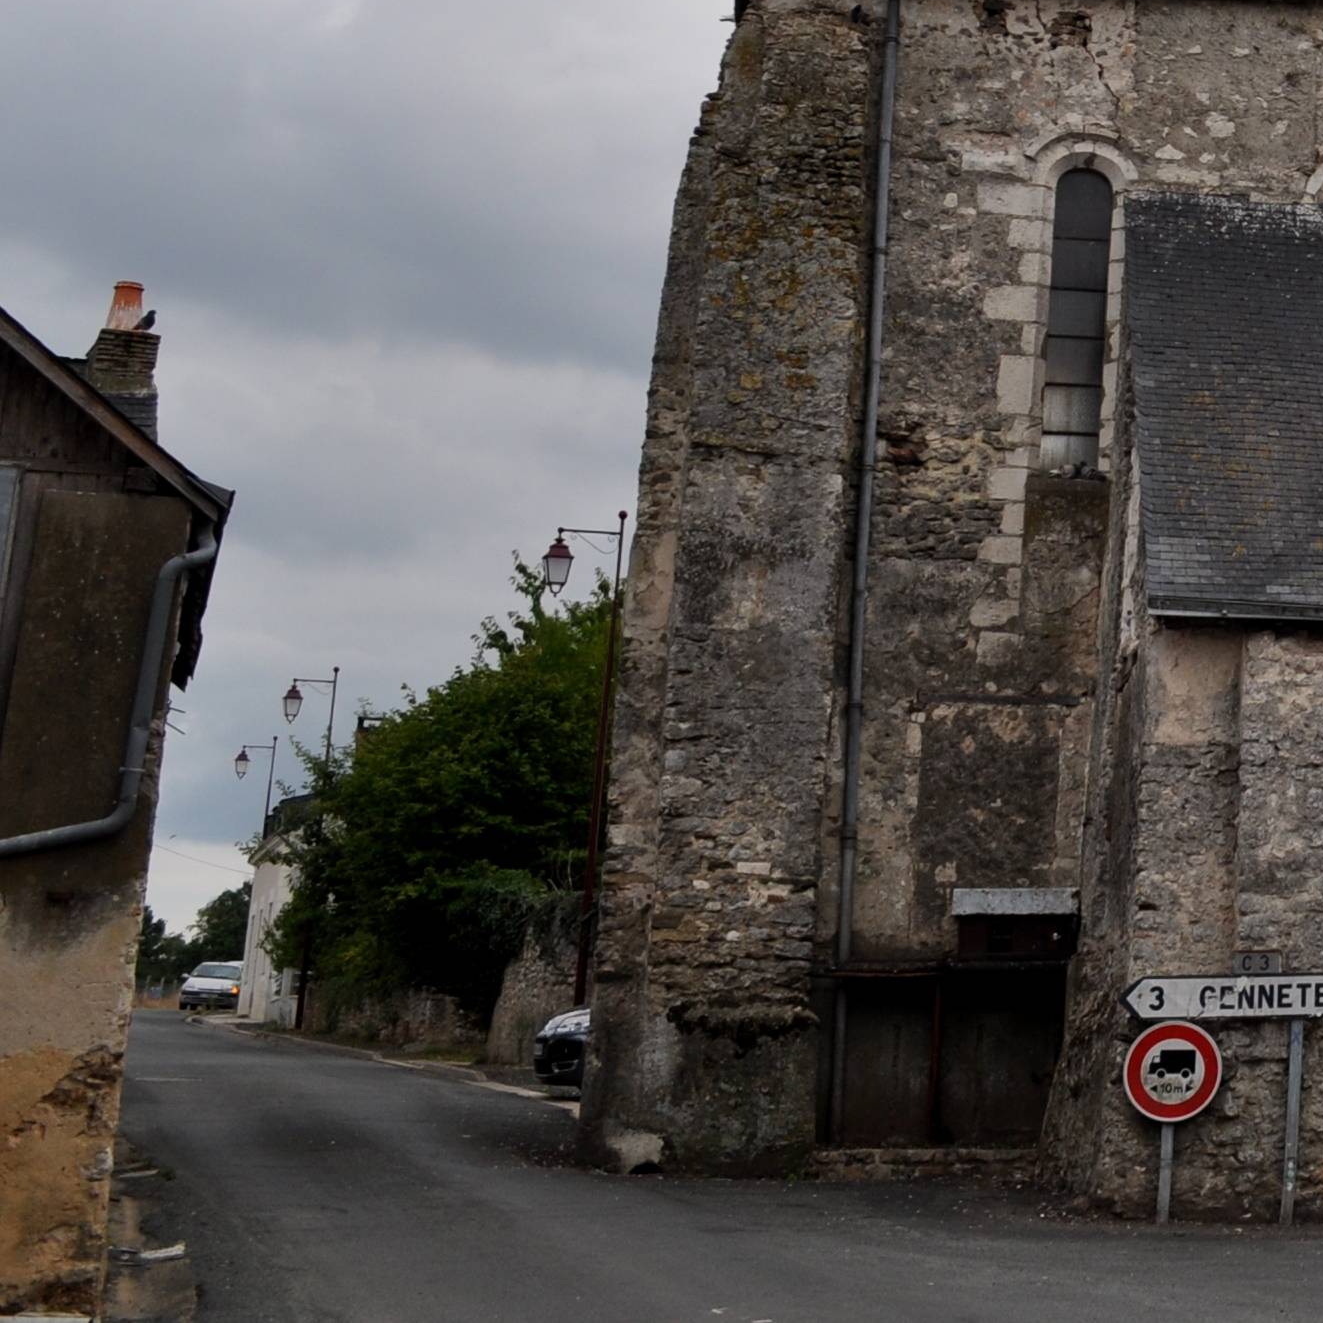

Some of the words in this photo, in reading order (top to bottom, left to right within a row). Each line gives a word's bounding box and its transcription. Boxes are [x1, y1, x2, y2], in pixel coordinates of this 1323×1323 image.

[1242, 955, 1251, 971] C
[1260, 954, 1269, 971] 3
[1149, 985, 1165, 1011] 3
